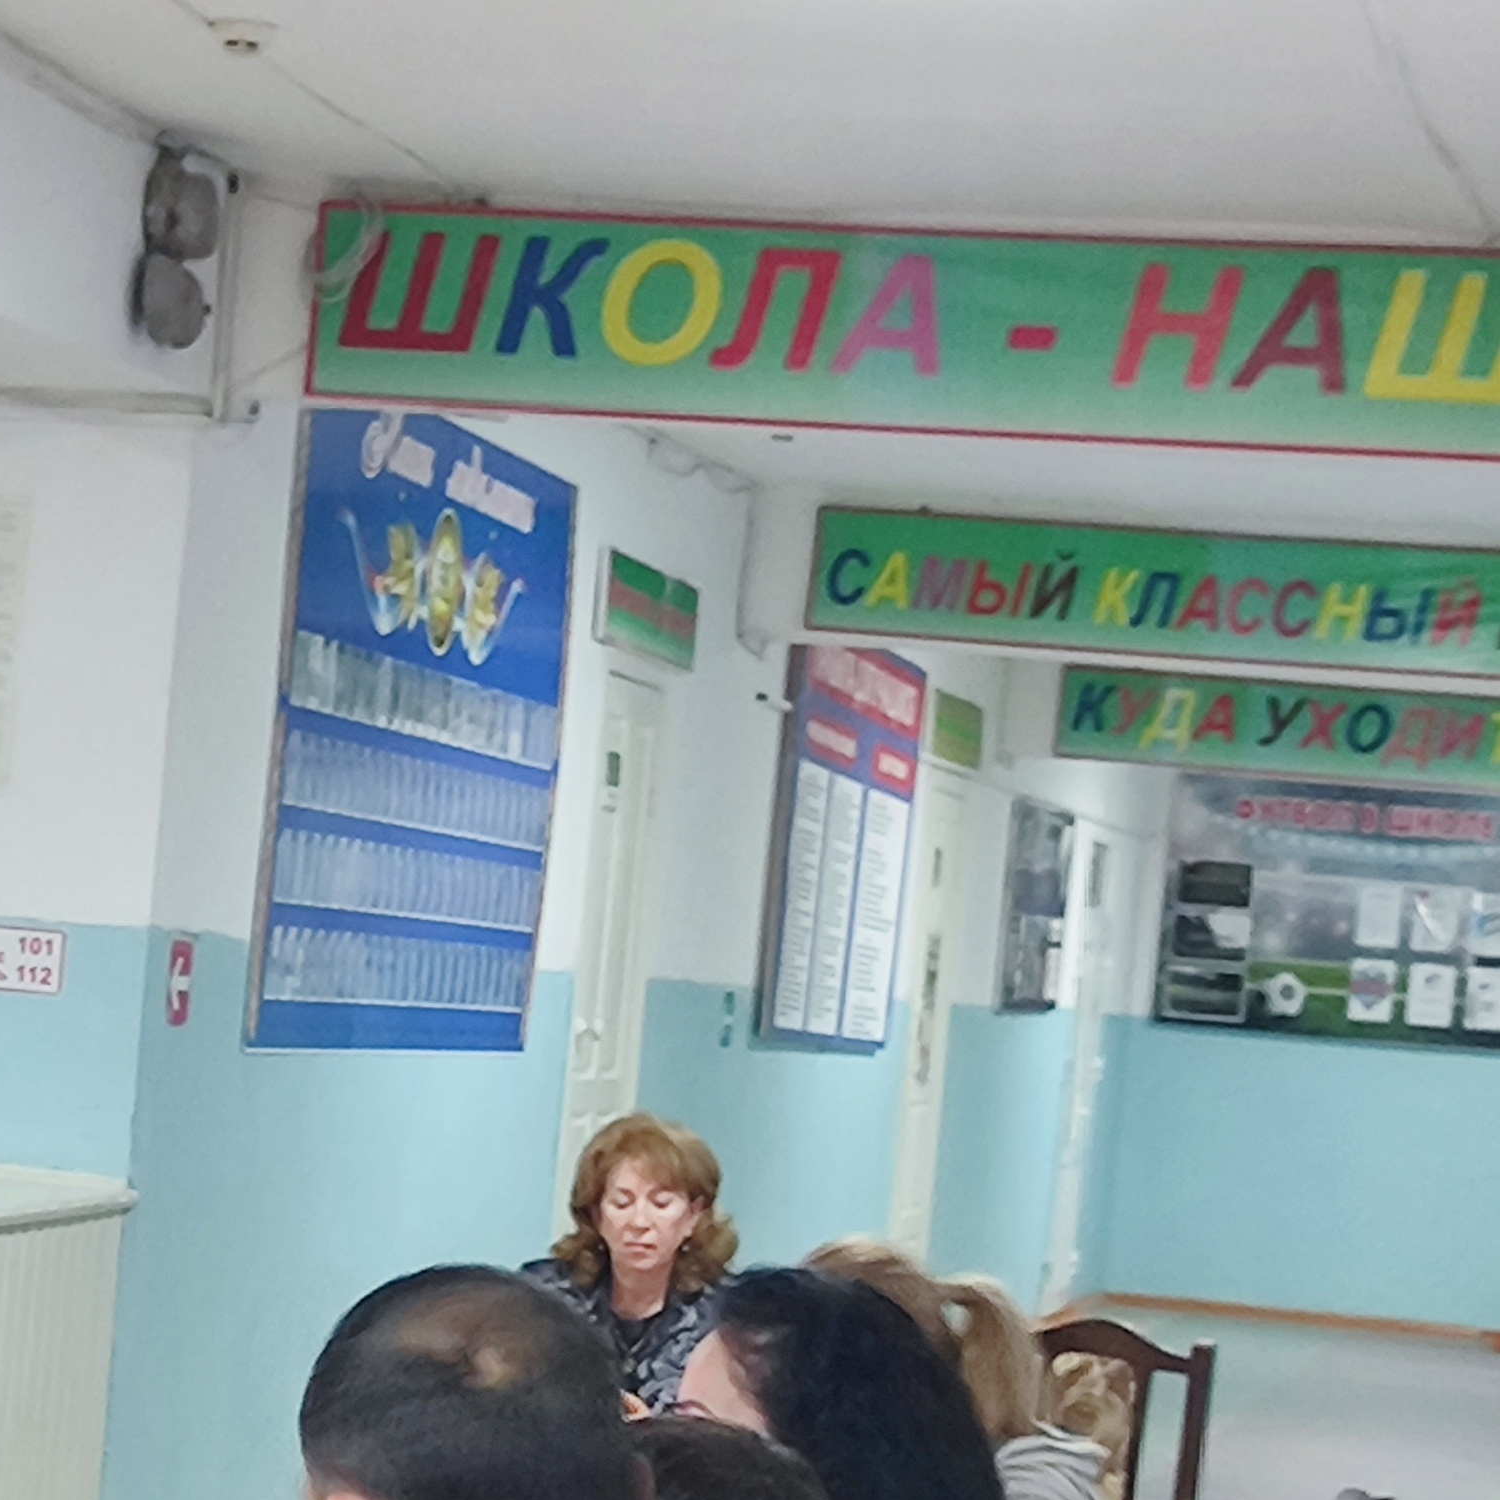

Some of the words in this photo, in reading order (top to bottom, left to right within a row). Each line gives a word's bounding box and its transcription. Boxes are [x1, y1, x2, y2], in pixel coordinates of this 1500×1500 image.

[338, 231, 940, 378] ШКОЛА
[1109, 261, 1500, 405] НАШ
[826, 548, 1081, 621] САМЫЙ
[1093, 566, 1485, 649] КЛАССНЫЙ
[1072, 681, 1237, 753] КУДА
[1256, 694, 1500, 772] УХОДИ
[16, 964, 52, 986] 112
[19, 936, 54, 957] 101
